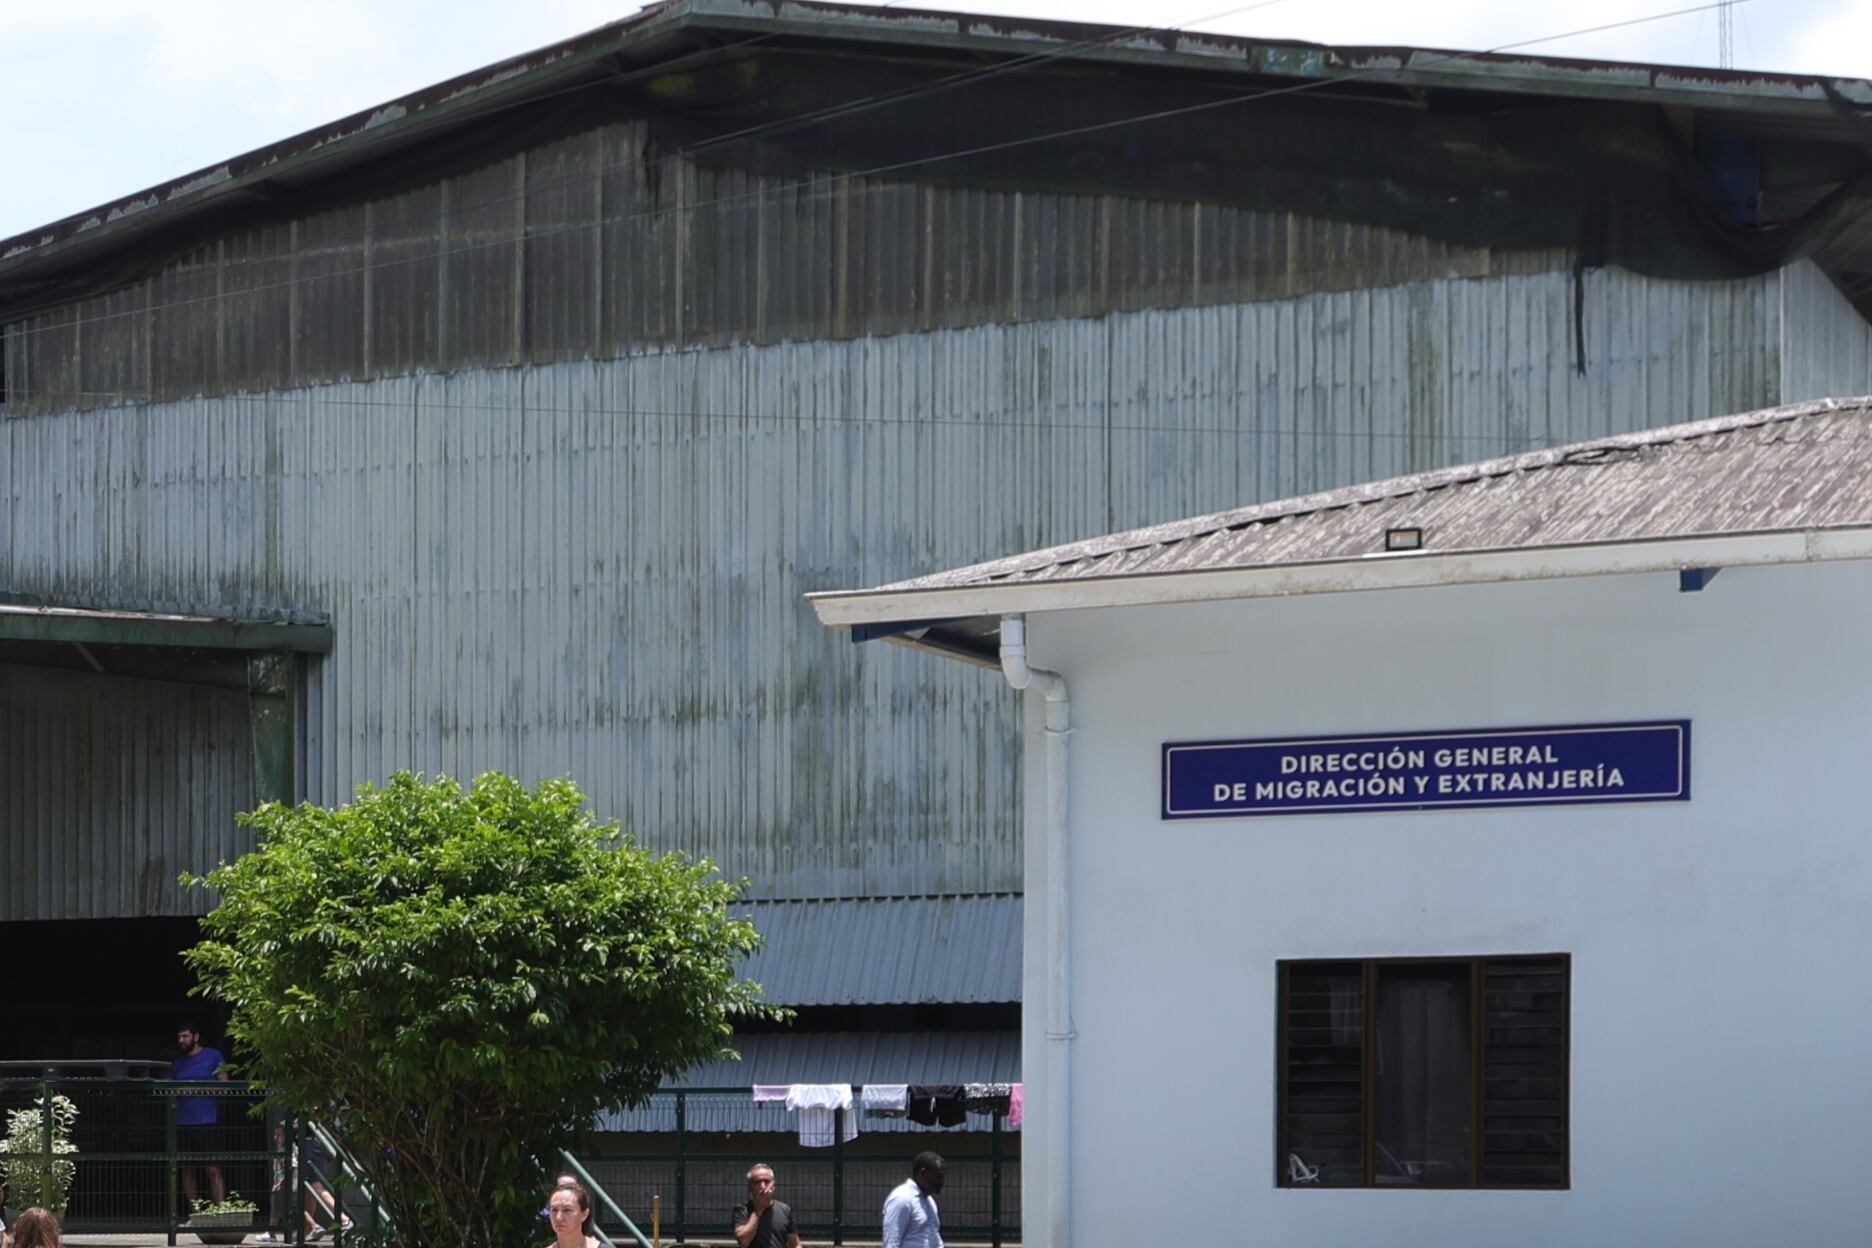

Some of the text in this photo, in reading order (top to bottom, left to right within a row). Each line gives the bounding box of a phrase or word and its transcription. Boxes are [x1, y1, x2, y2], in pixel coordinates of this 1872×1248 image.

[1281, 745, 1559, 774] DIRECCIÓN GENERAL
[1214, 763, 1625, 802] DE MIGRACIÓN Y EXTRANJERÍA
